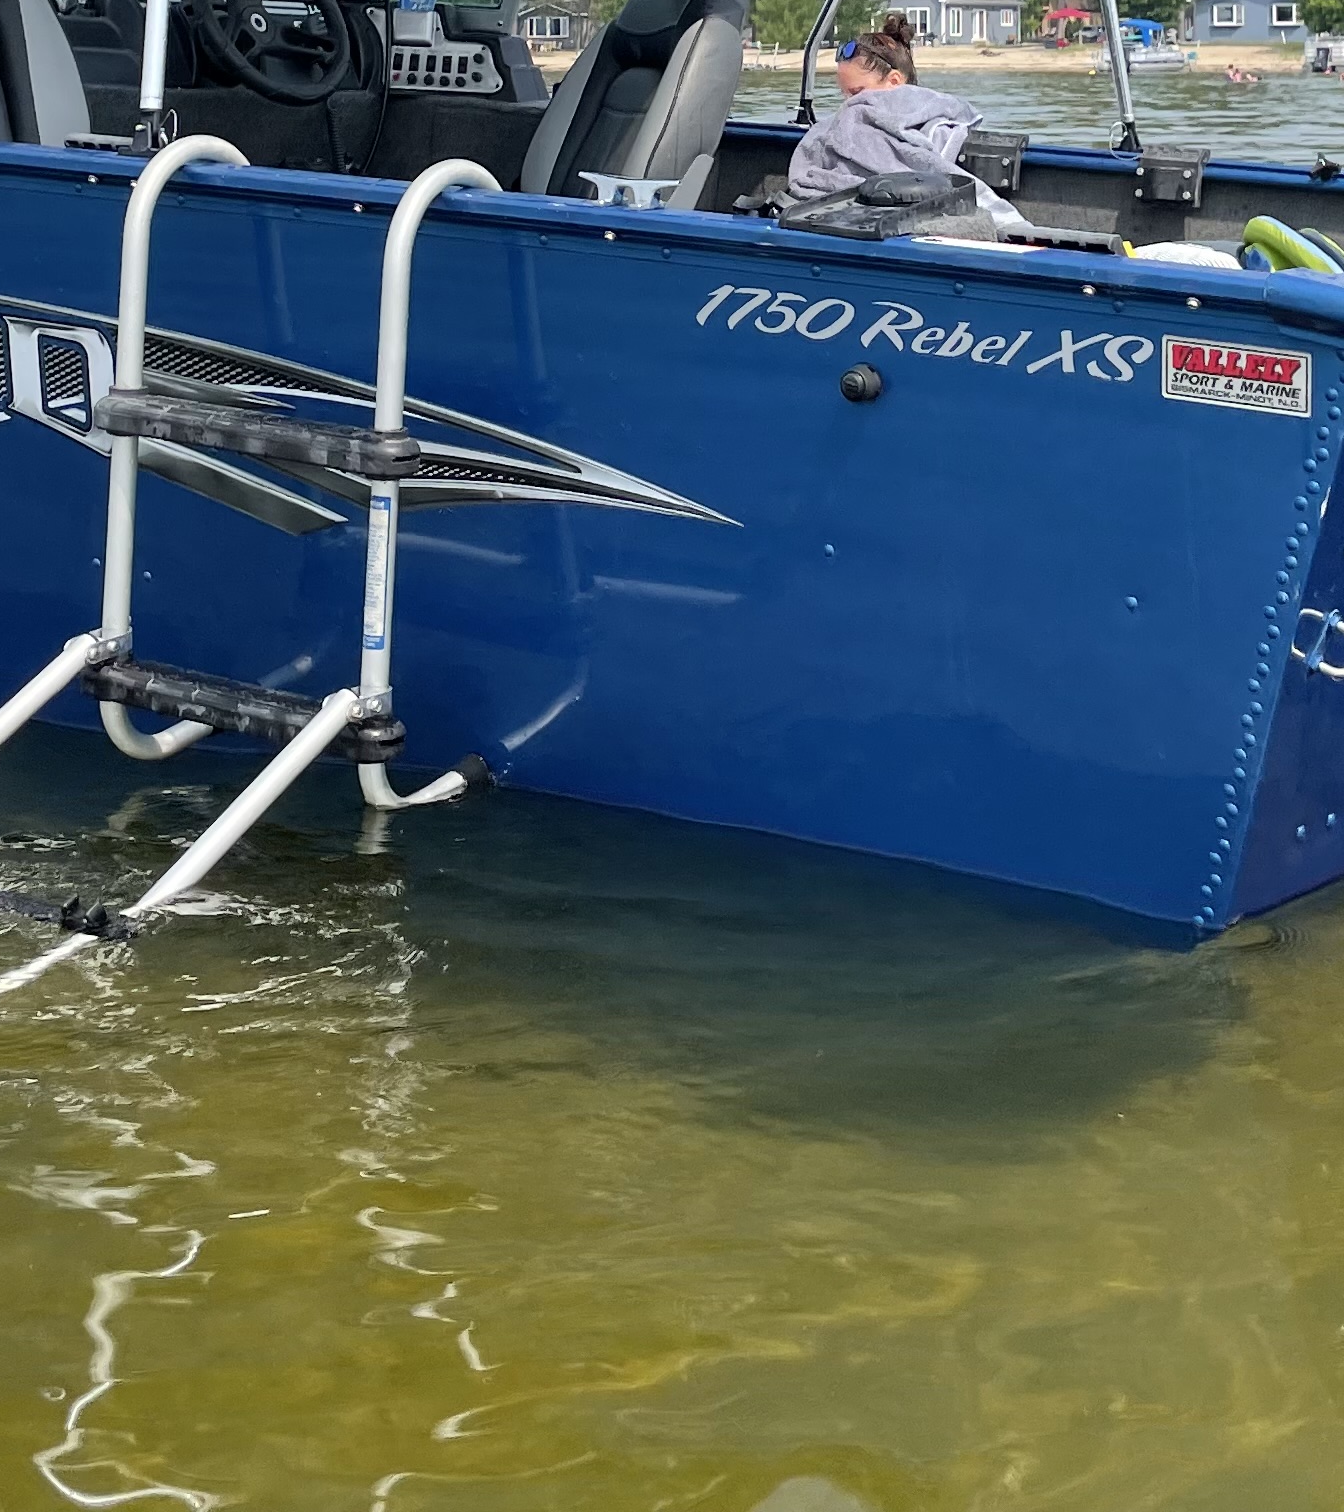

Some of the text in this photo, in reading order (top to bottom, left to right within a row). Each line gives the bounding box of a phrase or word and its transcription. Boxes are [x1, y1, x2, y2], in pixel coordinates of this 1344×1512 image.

[695, 284, 1155, 383] 1750 Rebel XS
[1171, 371, 1302, 400] SPORT & MARINE
